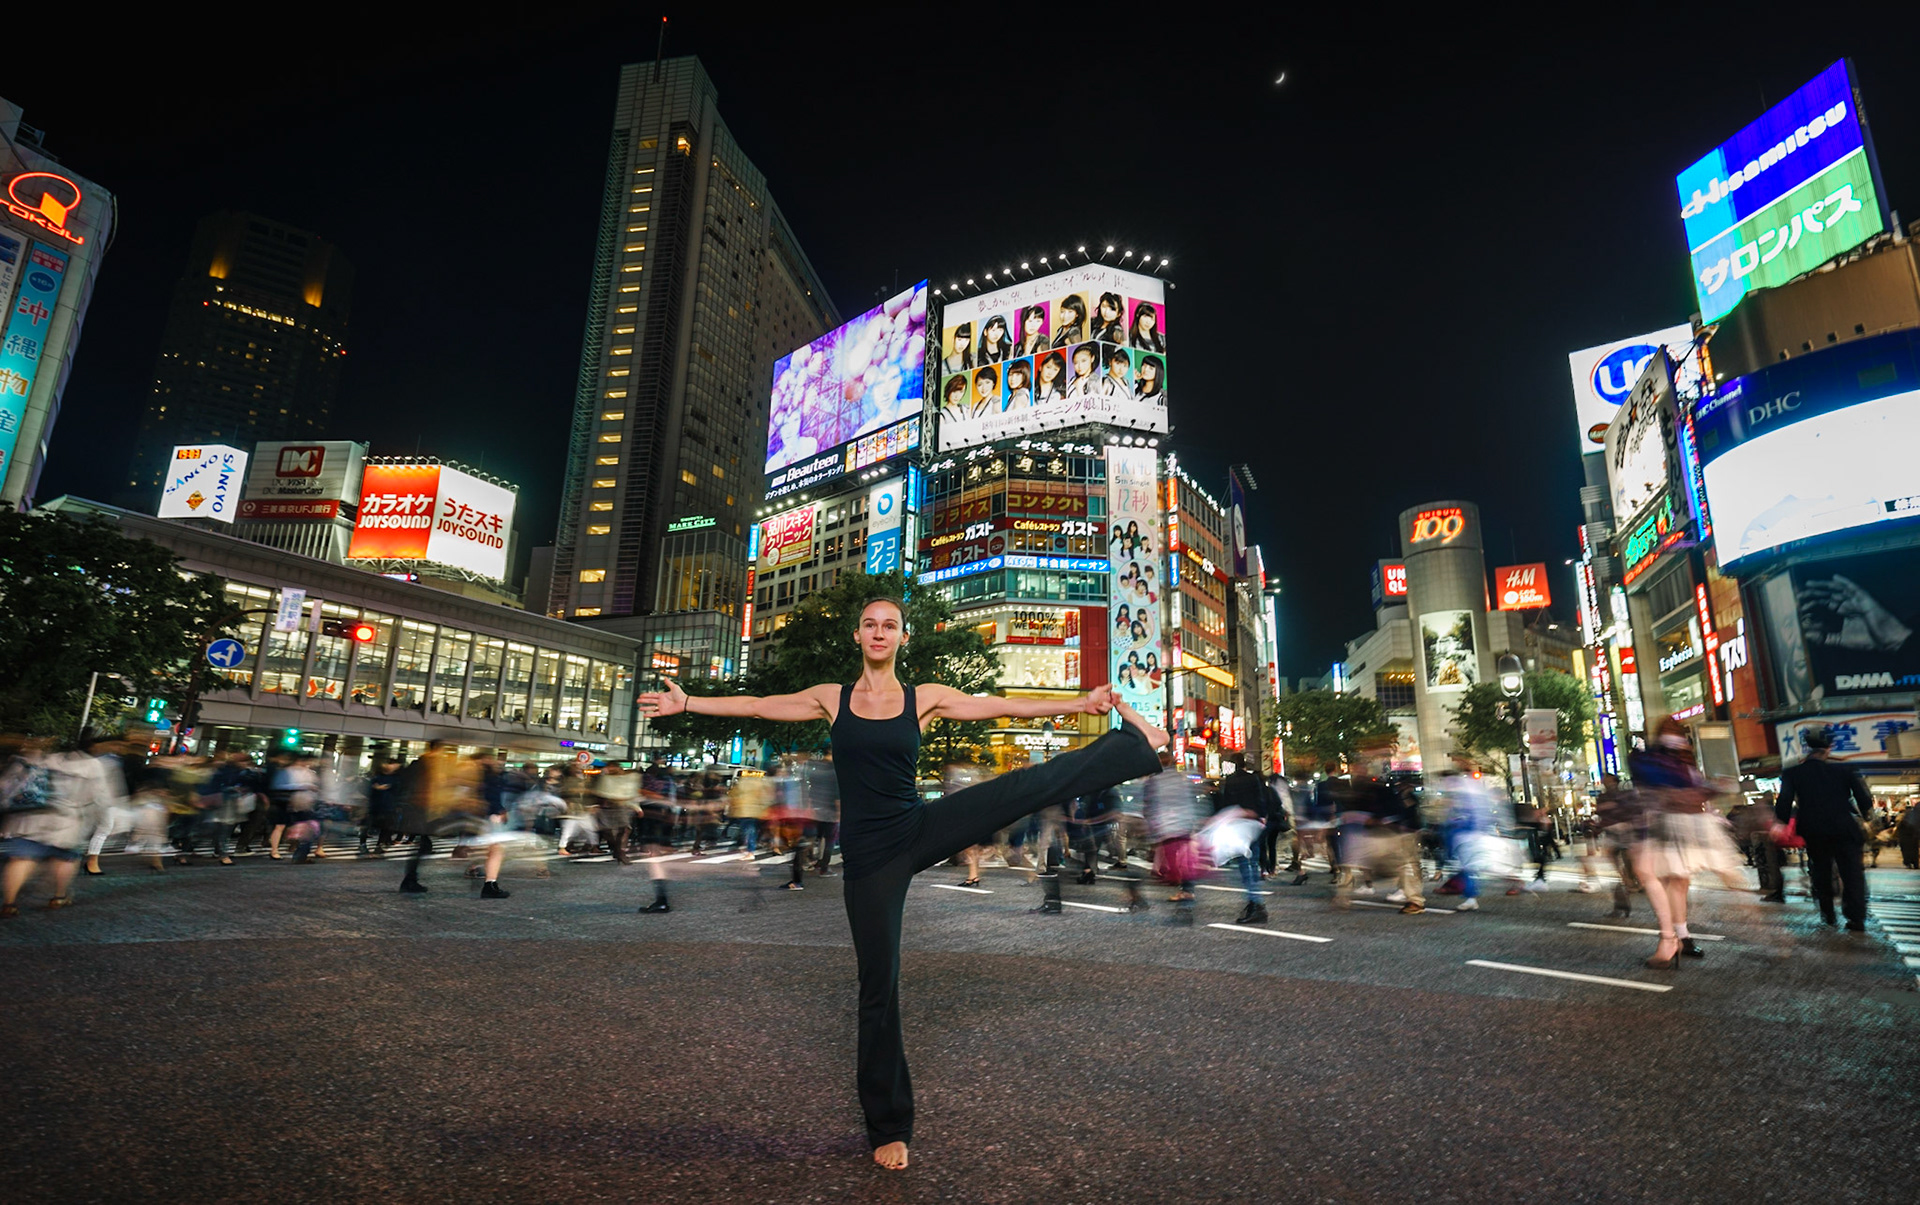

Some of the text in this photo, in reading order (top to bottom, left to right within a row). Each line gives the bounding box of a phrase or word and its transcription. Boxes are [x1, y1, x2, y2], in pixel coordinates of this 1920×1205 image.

[0, 198, 85, 245] OKYU
[1700, 183, 1862, 295] サロンパス
[1749, 391, 1802, 426] DHC
[280, 450, 319, 473] DC
[786, 453, 839, 482] Beauteen
[212, 453, 236, 513] SANKYO
[277, 486, 324, 496] MasterCard
[1129, 477, 1151, 487] Single
[262, 504, 332, 515] 三菱東京UFJ銀行
[362, 493, 434, 515] カラオケ
[1008, 494, 1085, 512] コンタクト
[1117, 488, 1149, 513] 12秒
[358, 514, 432, 530] JOYSOUND
[442, 497, 504, 534] うたスキ
[1418, 507, 1462, 519] SHIBUYA
[436, 518, 504, 550] JOYSOUND
[766, 511, 813, 538] 品川スキン
[965, 522, 995, 542] ガスト
[1060, 520, 1099, 537] ガスト
[1410, 514, 1465, 545] 109
[766, 525, 812, 551] クリニック
[919, 558, 932, 571] 7F
[950, 544, 985, 567] ガスト
[1038, 557, 1108, 571] 英会話イーオン
[936, 561, 988, 581] 英会話イーオン
[1506, 567, 1536, 588] H&M
[1013, 610, 1057, 624] 1000%
